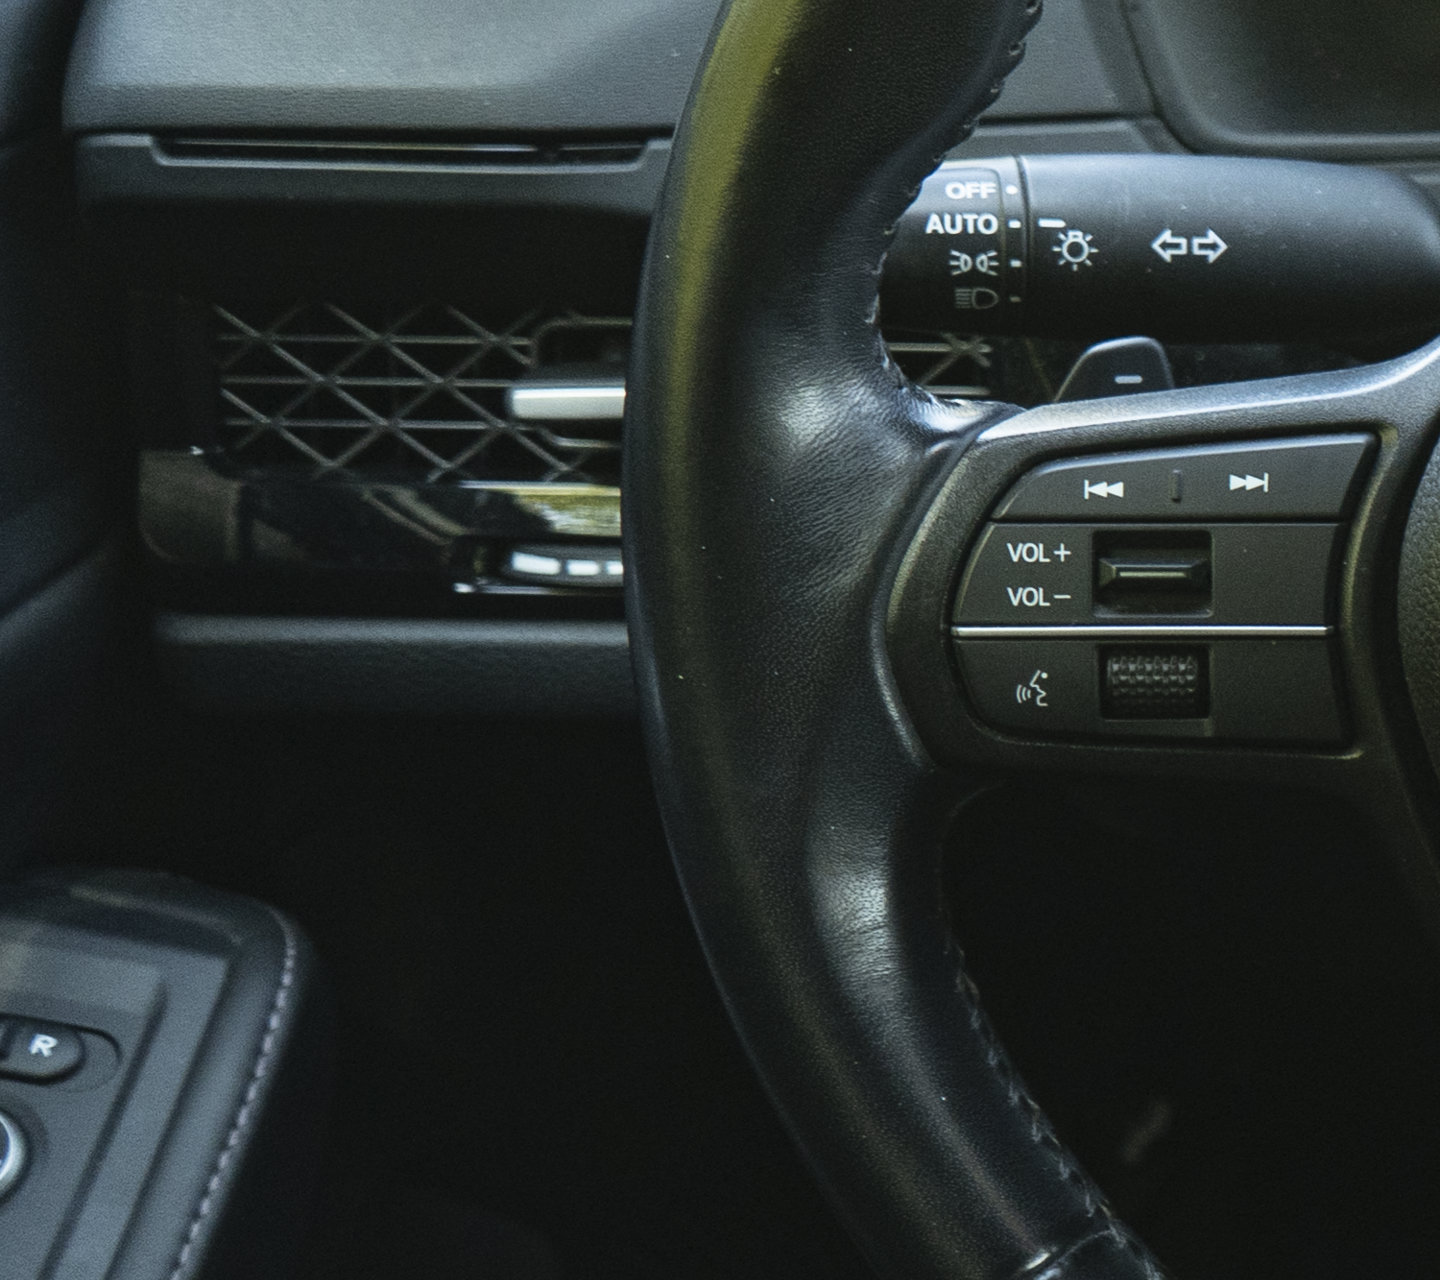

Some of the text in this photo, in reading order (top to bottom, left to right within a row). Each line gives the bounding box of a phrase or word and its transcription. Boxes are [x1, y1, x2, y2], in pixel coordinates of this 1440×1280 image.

[942, 178, 998, 202] OFF
[924, 213, 999, 236] AUTO
[29, 1033, 58, 1058] R
